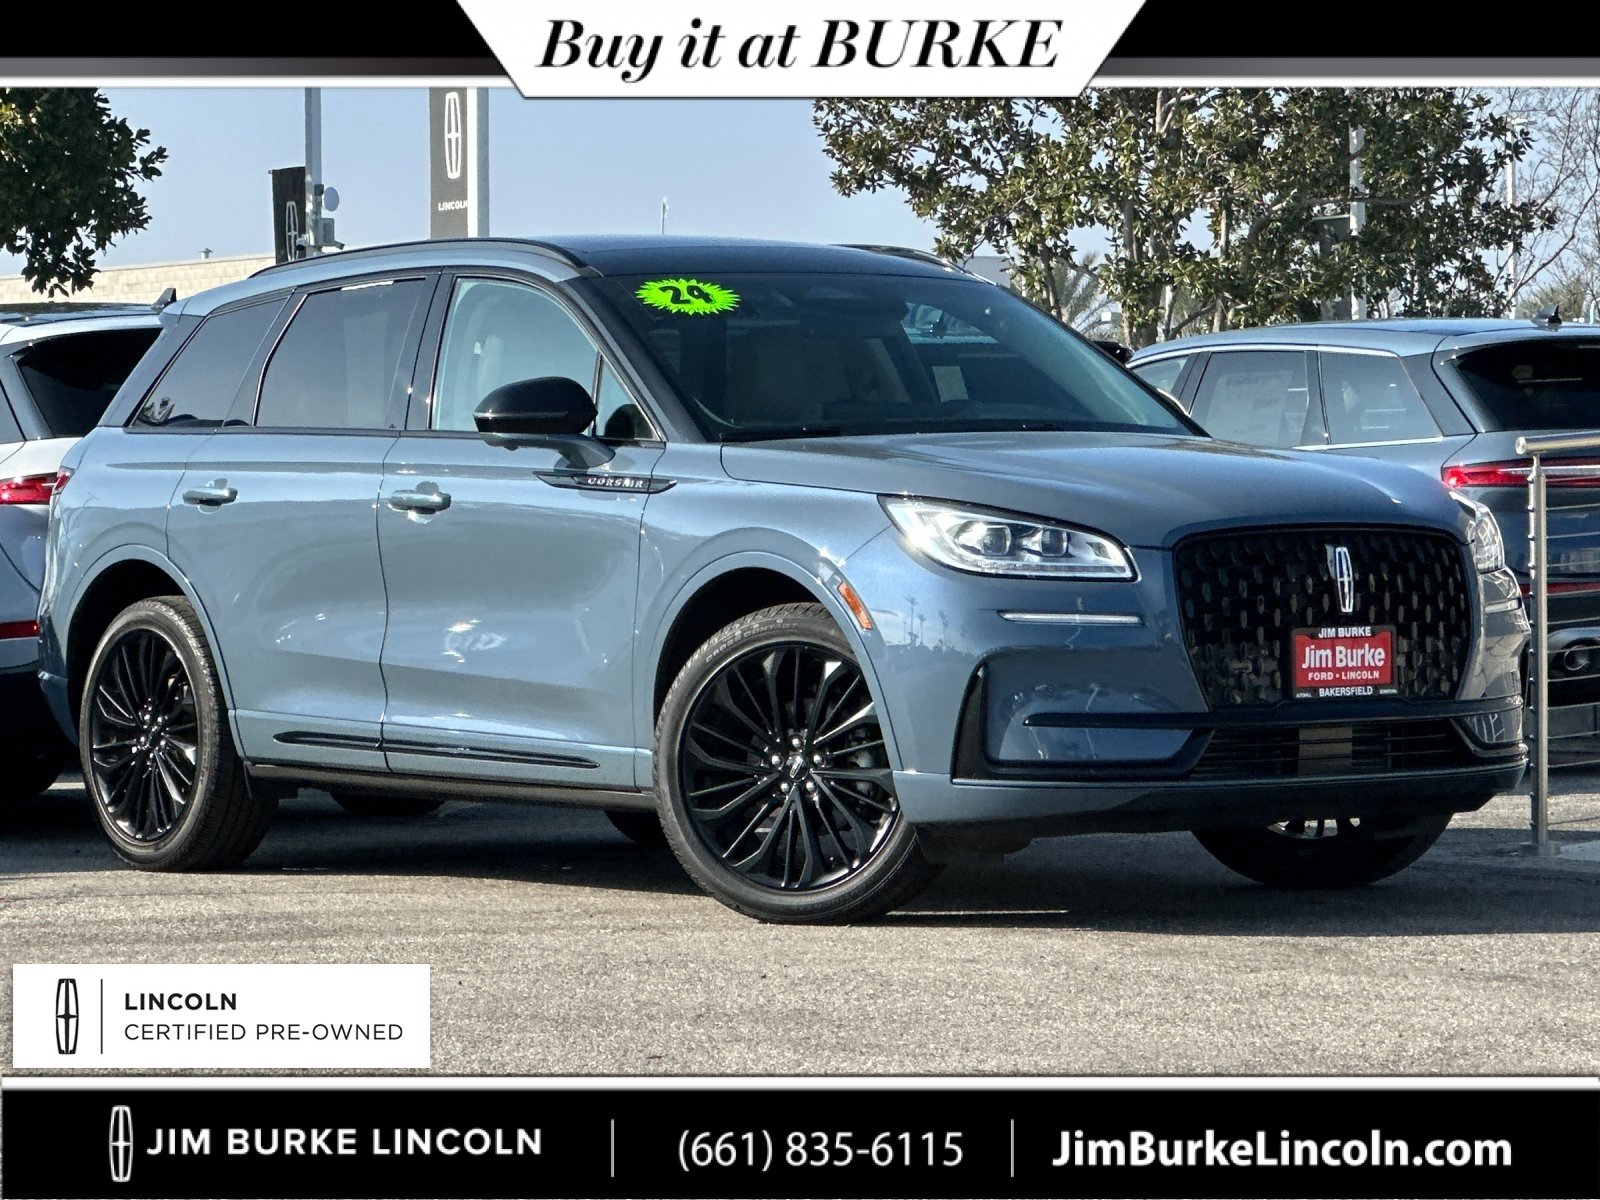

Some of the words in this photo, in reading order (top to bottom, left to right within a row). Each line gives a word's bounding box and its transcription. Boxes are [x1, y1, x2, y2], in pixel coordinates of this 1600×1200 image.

[659, 285, 714, 304] 24
[587, 477, 644, 488] CORSAIR
[1318, 628, 1336, 638] JIM
[1338, 626, 1372, 637] BURKE
[1302, 644, 1333, 669] Jim
[1335, 643, 1386, 668] Burke
[1308, 672, 1334, 681] FORD
[1341, 671, 1380, 680] LINCOLN
[1319, 686, 1373, 697] BAKERSFIELD
